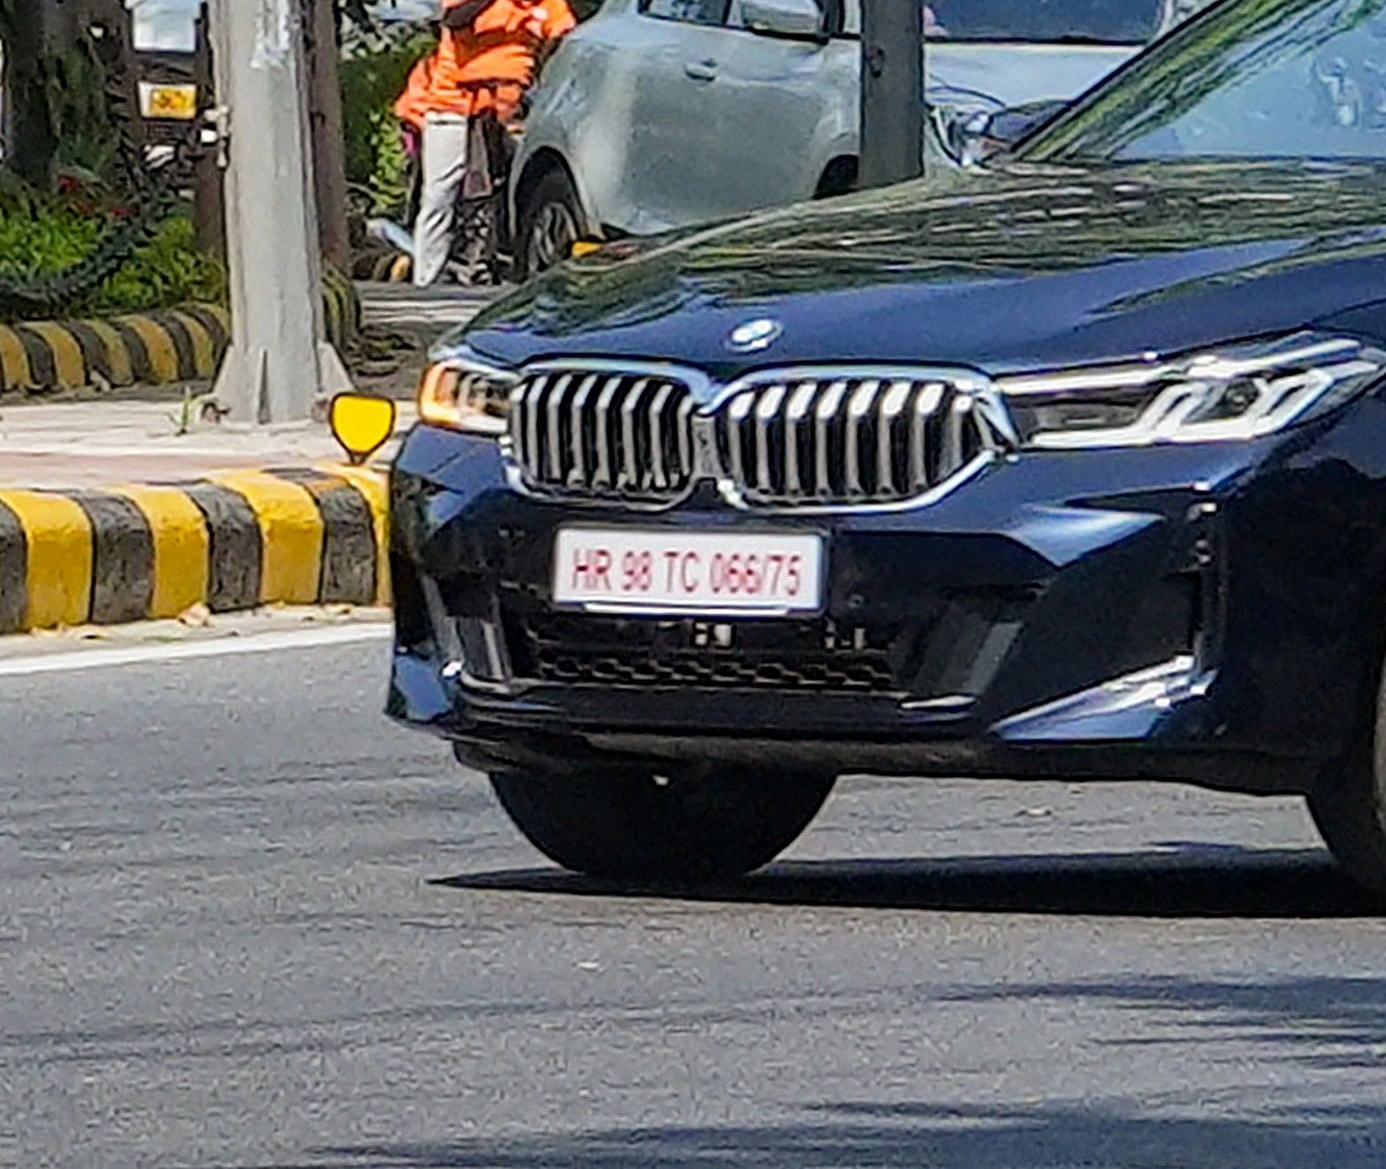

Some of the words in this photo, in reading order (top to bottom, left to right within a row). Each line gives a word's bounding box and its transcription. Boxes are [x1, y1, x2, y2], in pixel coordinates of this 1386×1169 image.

[571, 548, 613, 591] HR
[621, 549, 653, 592] 98
[663, 550, 701, 594] TC
